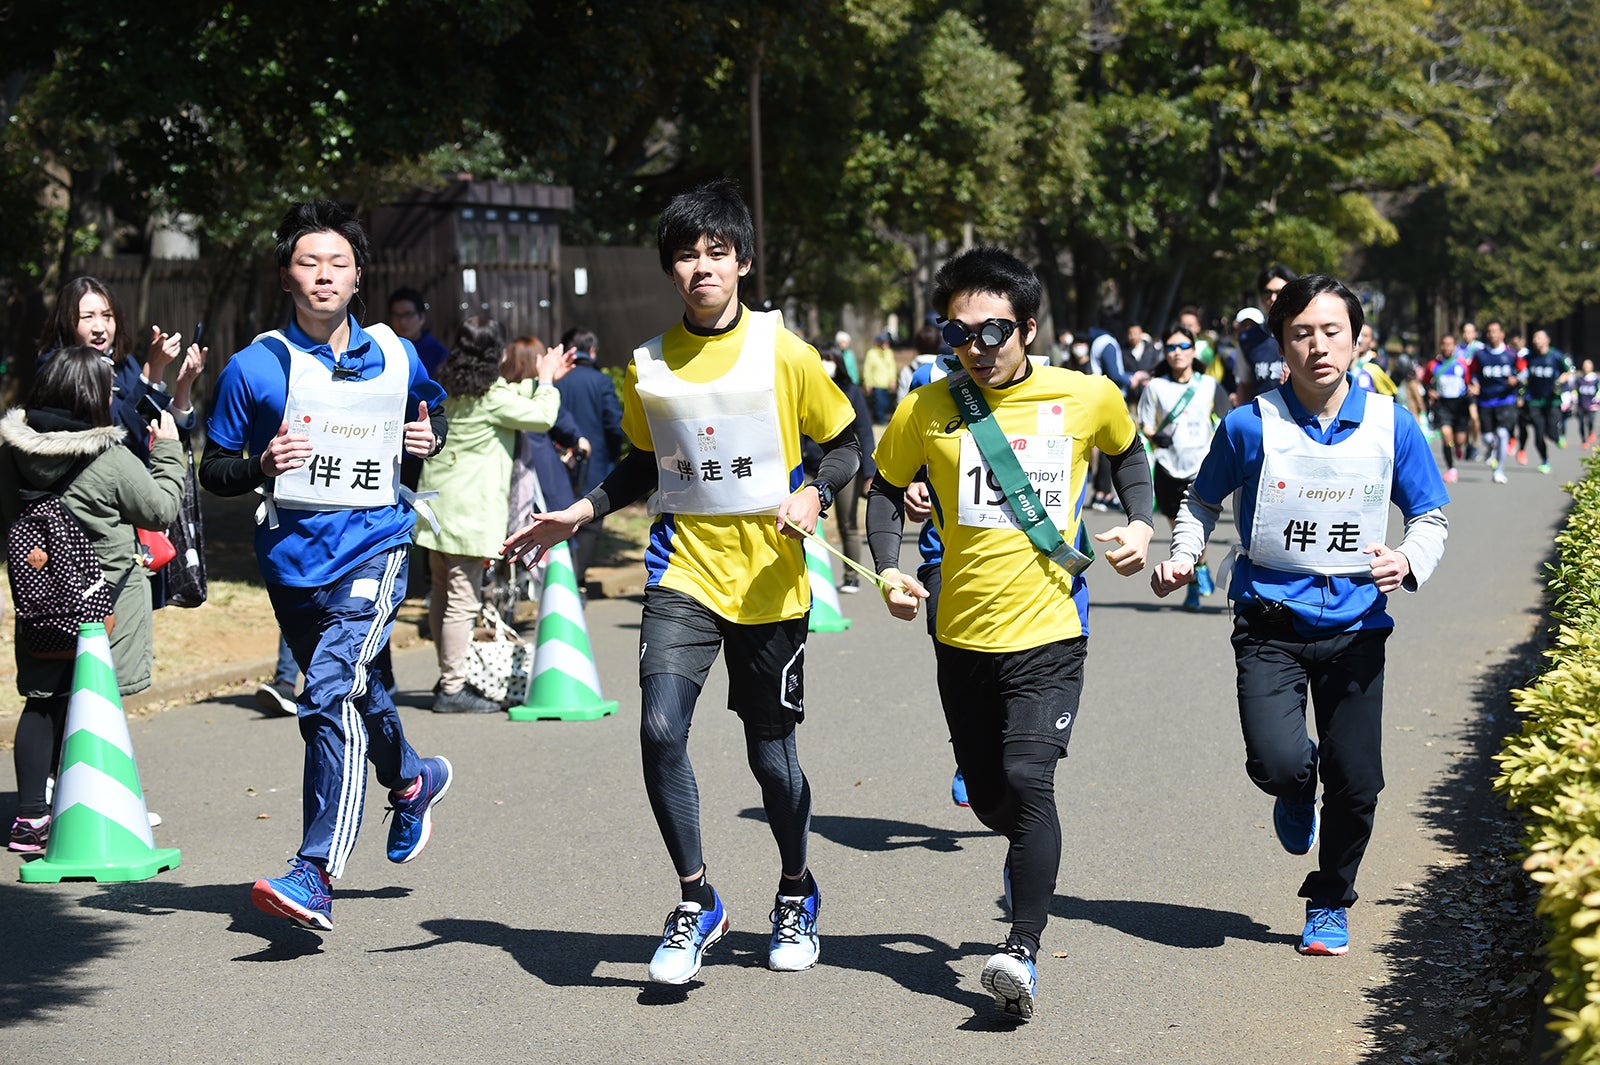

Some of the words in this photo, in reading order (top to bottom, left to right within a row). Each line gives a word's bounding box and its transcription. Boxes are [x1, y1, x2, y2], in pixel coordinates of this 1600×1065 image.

[1009, 438, 1027, 450] TB
[308, 454, 381, 490] 伴走
[677, 456, 753, 482] 伴走者
[1283, 519, 1361, 553] 伴走
